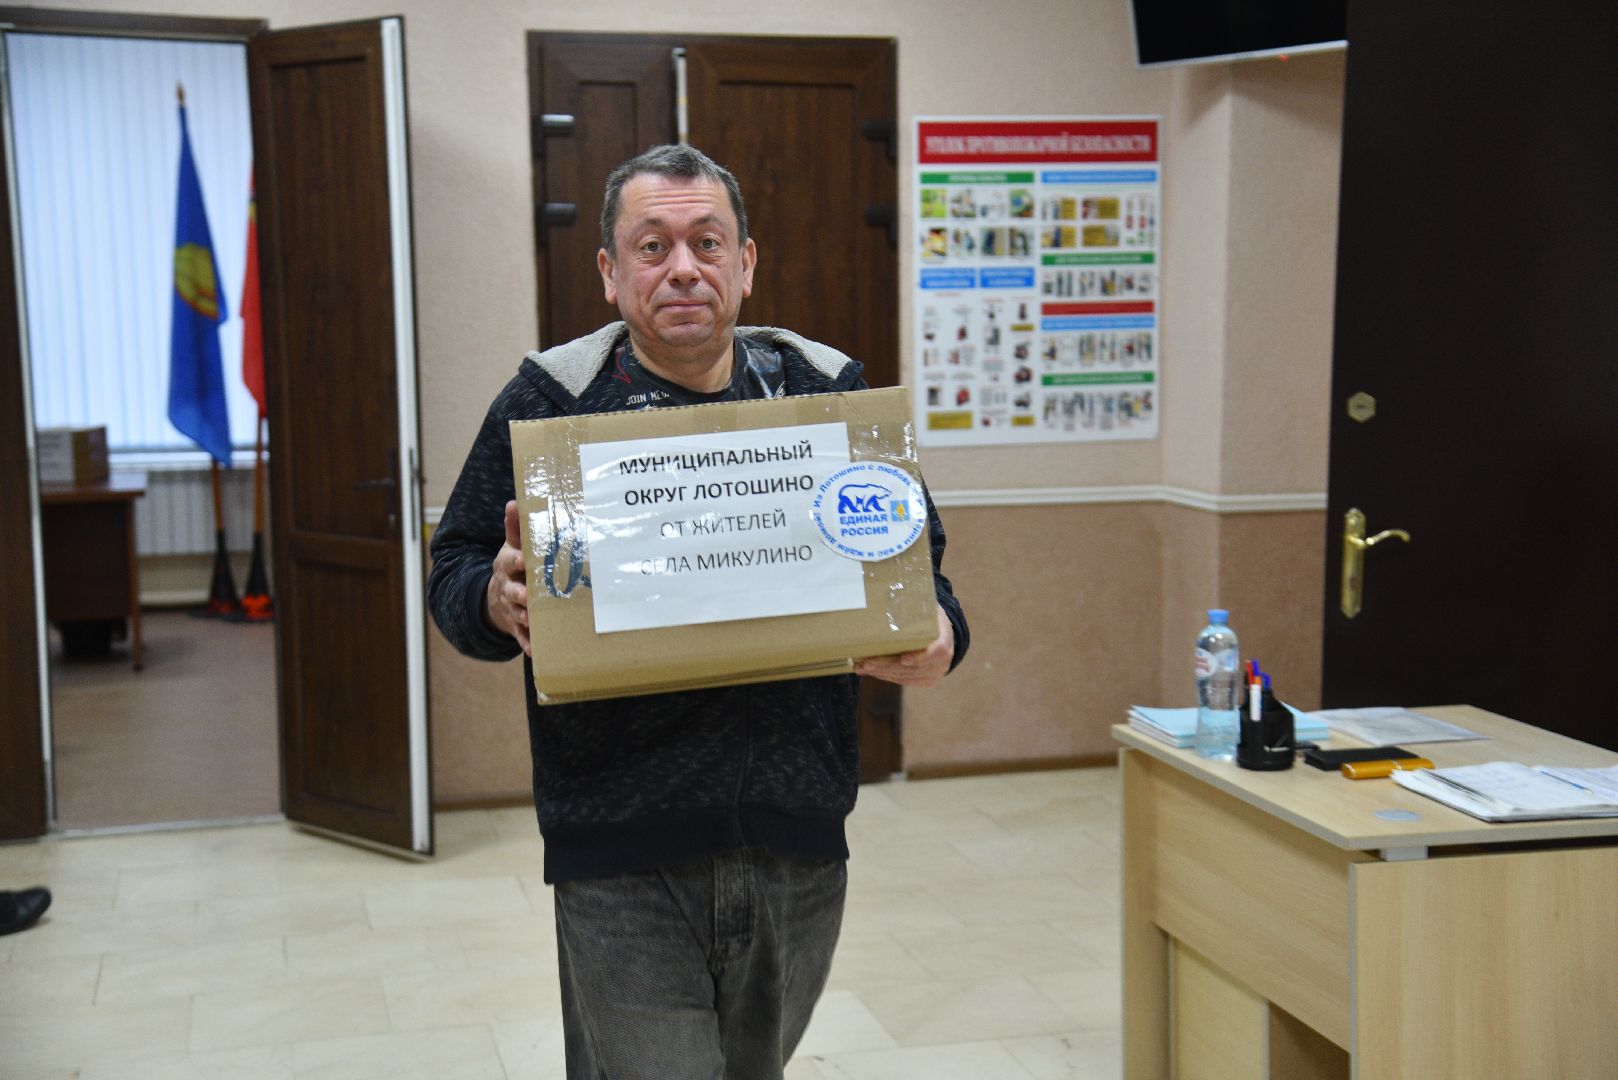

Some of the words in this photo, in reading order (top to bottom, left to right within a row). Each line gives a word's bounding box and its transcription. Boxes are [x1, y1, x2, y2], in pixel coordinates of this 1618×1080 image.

[626, 393, 647, 406] JOIN
[619, 440, 813, 475] МУНИЦИПАЛЬНЫЙ
[624, 486, 687, 506] ОКРУГ
[693, 474, 814, 500] ЛОТОШИНО
[813, 494, 823, 509] Из
[820, 464, 866, 494] Лотошино
[660, 519, 684, 538] ОТ
[693, 508, 787, 536] ЖИТЕЛЕЙ
[840, 514, 888, 526] ЕДИНАЯ
[841, 526, 889, 537] РОССИЯ
[640, 554, 692, 576] СЕЛА
[697, 545, 813, 571] МИКУЛИНО
